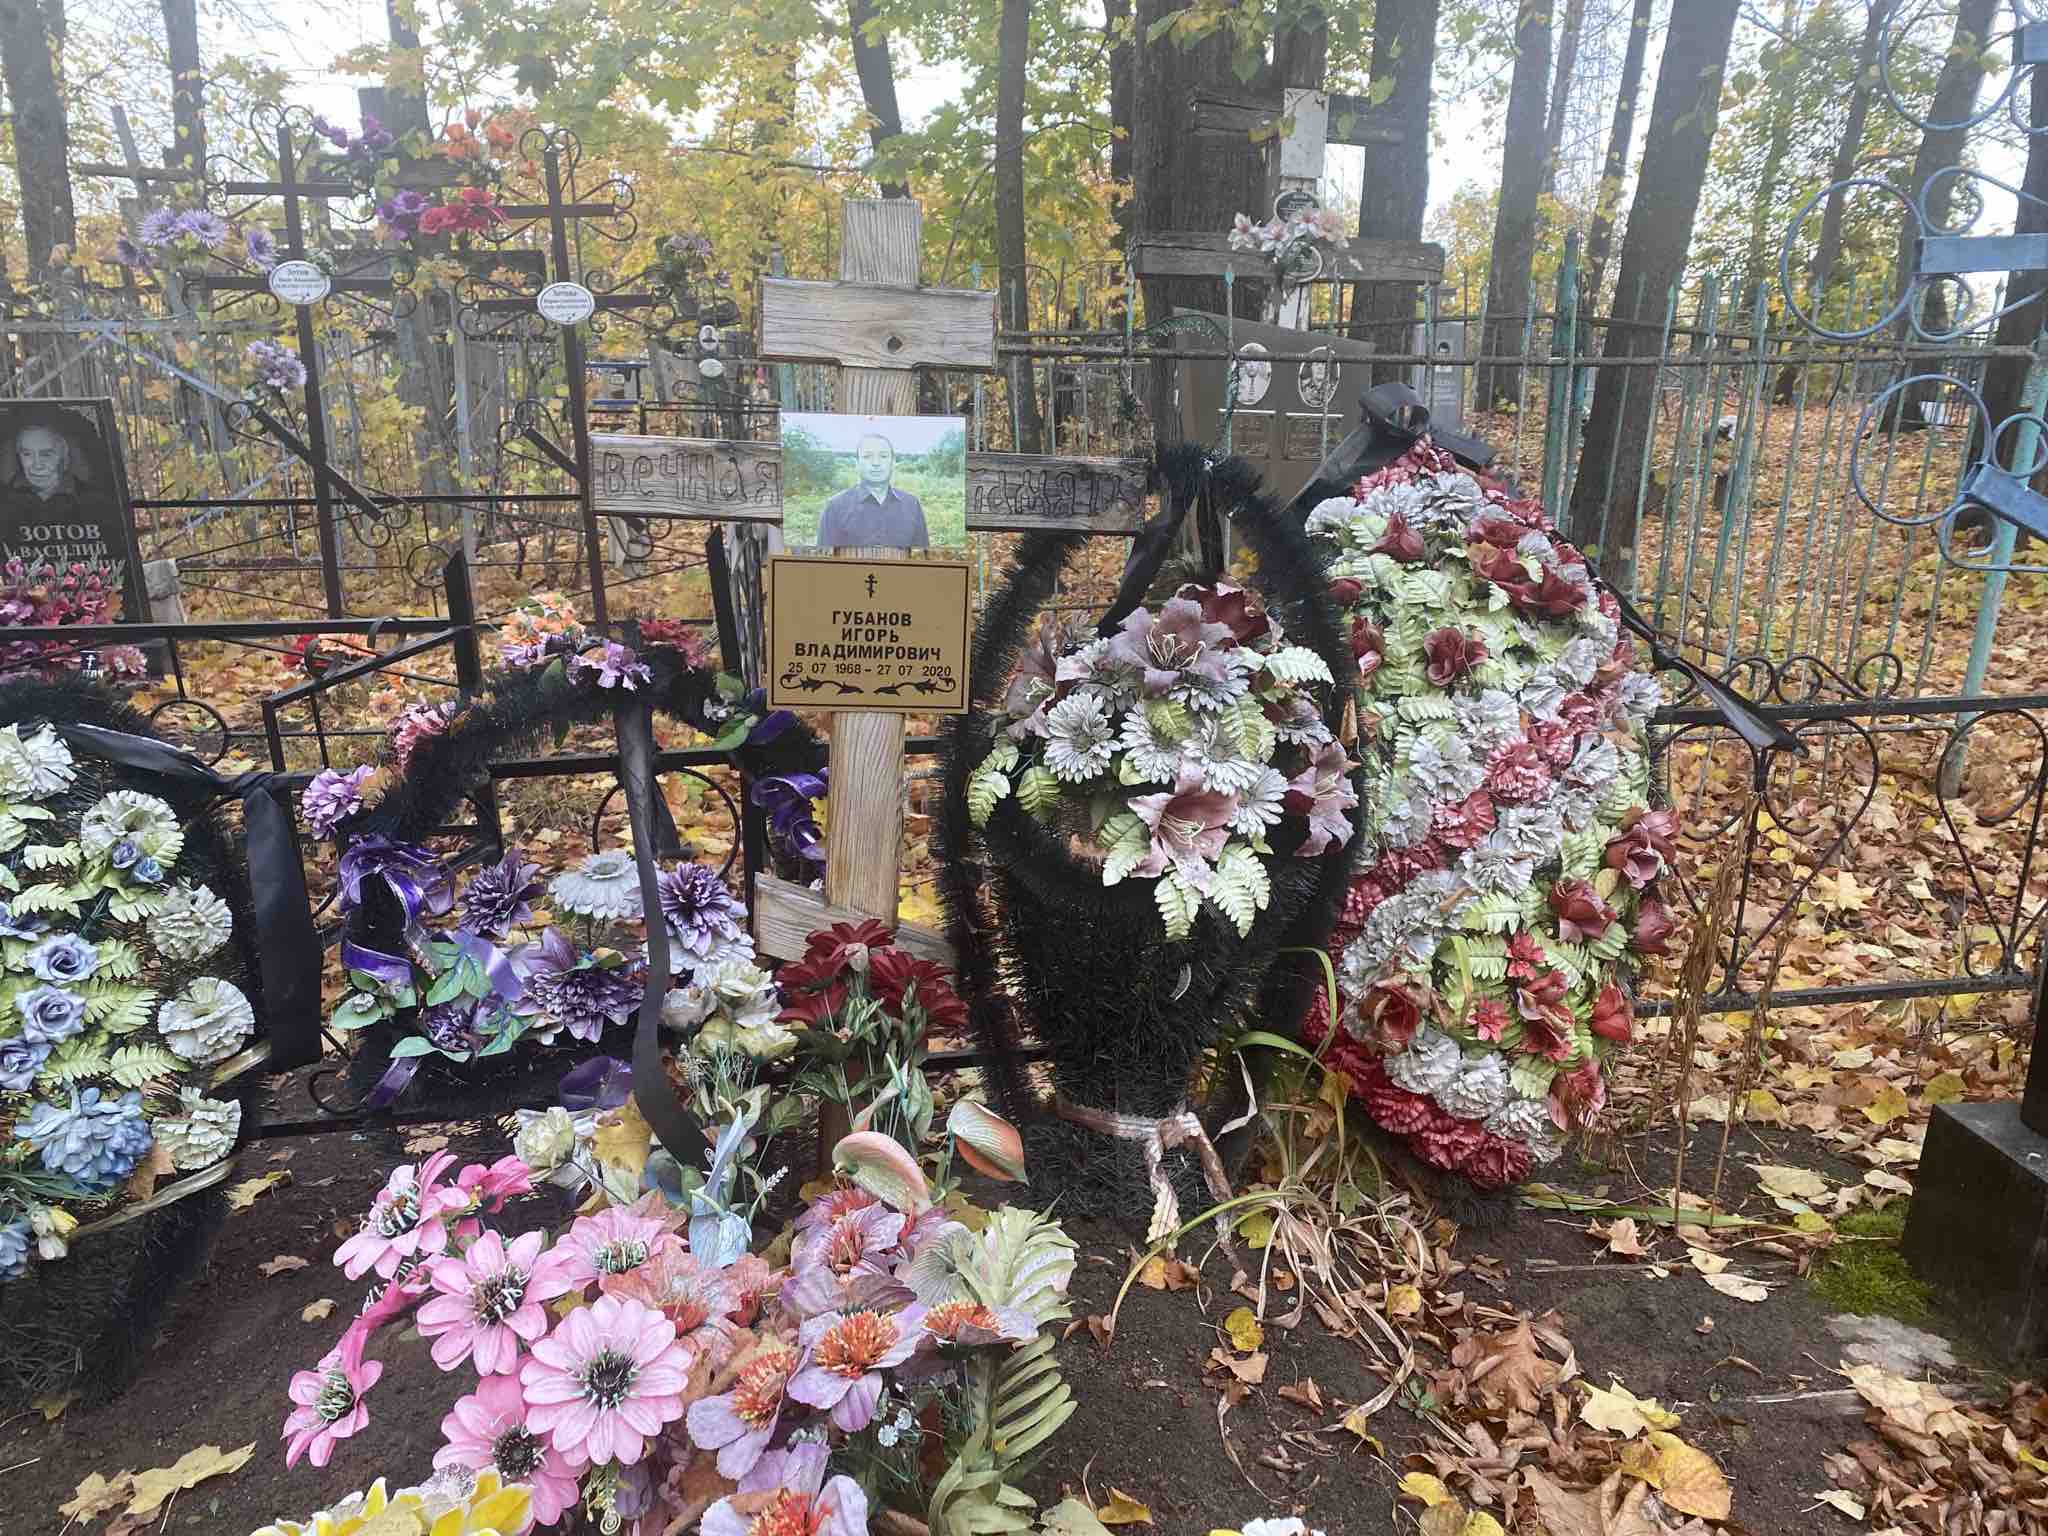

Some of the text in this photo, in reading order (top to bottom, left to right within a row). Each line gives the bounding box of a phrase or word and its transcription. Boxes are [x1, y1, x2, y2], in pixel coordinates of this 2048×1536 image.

[20, 525, 100, 541] ЗОТОВ
[832, 611, 912, 626] ГУБАНОВ
[841, 628, 899, 642] ИГОРЬ
[794, 643, 941, 660] ВЛАДИМИРОВИЧ
